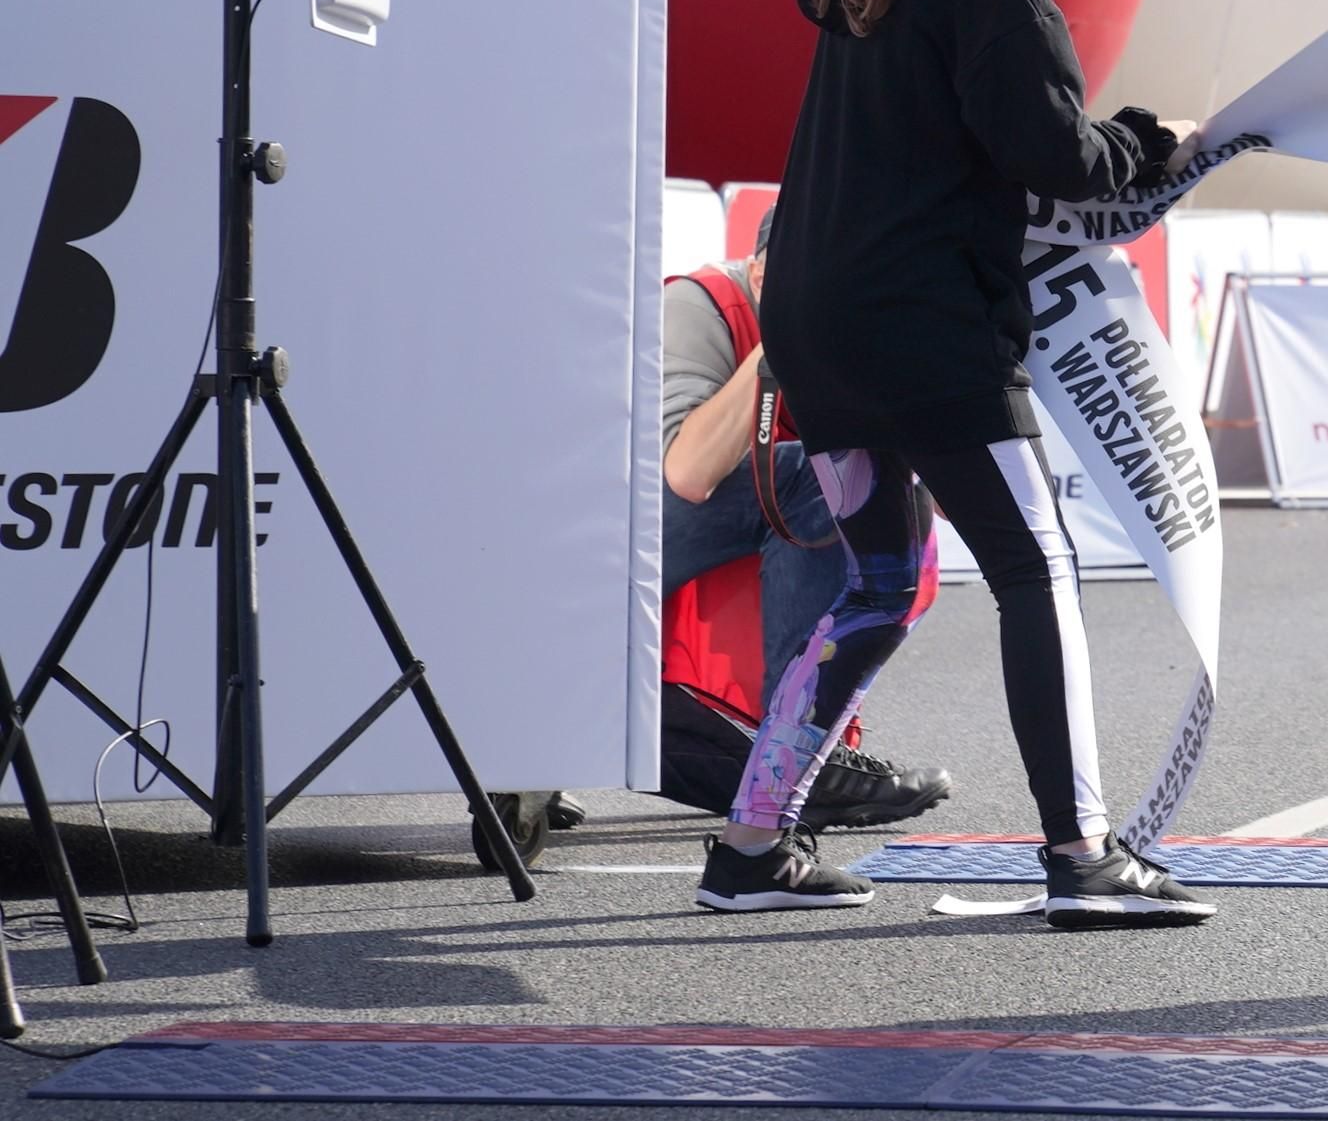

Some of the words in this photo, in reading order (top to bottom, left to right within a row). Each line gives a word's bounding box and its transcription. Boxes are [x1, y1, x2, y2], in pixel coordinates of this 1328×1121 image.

[758, 392, 775, 445] Canon
[1050, 340, 1197, 553] WARSZAWSKI
[1090, 317, 1216, 534] PÓŁMARATON
[0, 472, 280, 551] STONE
